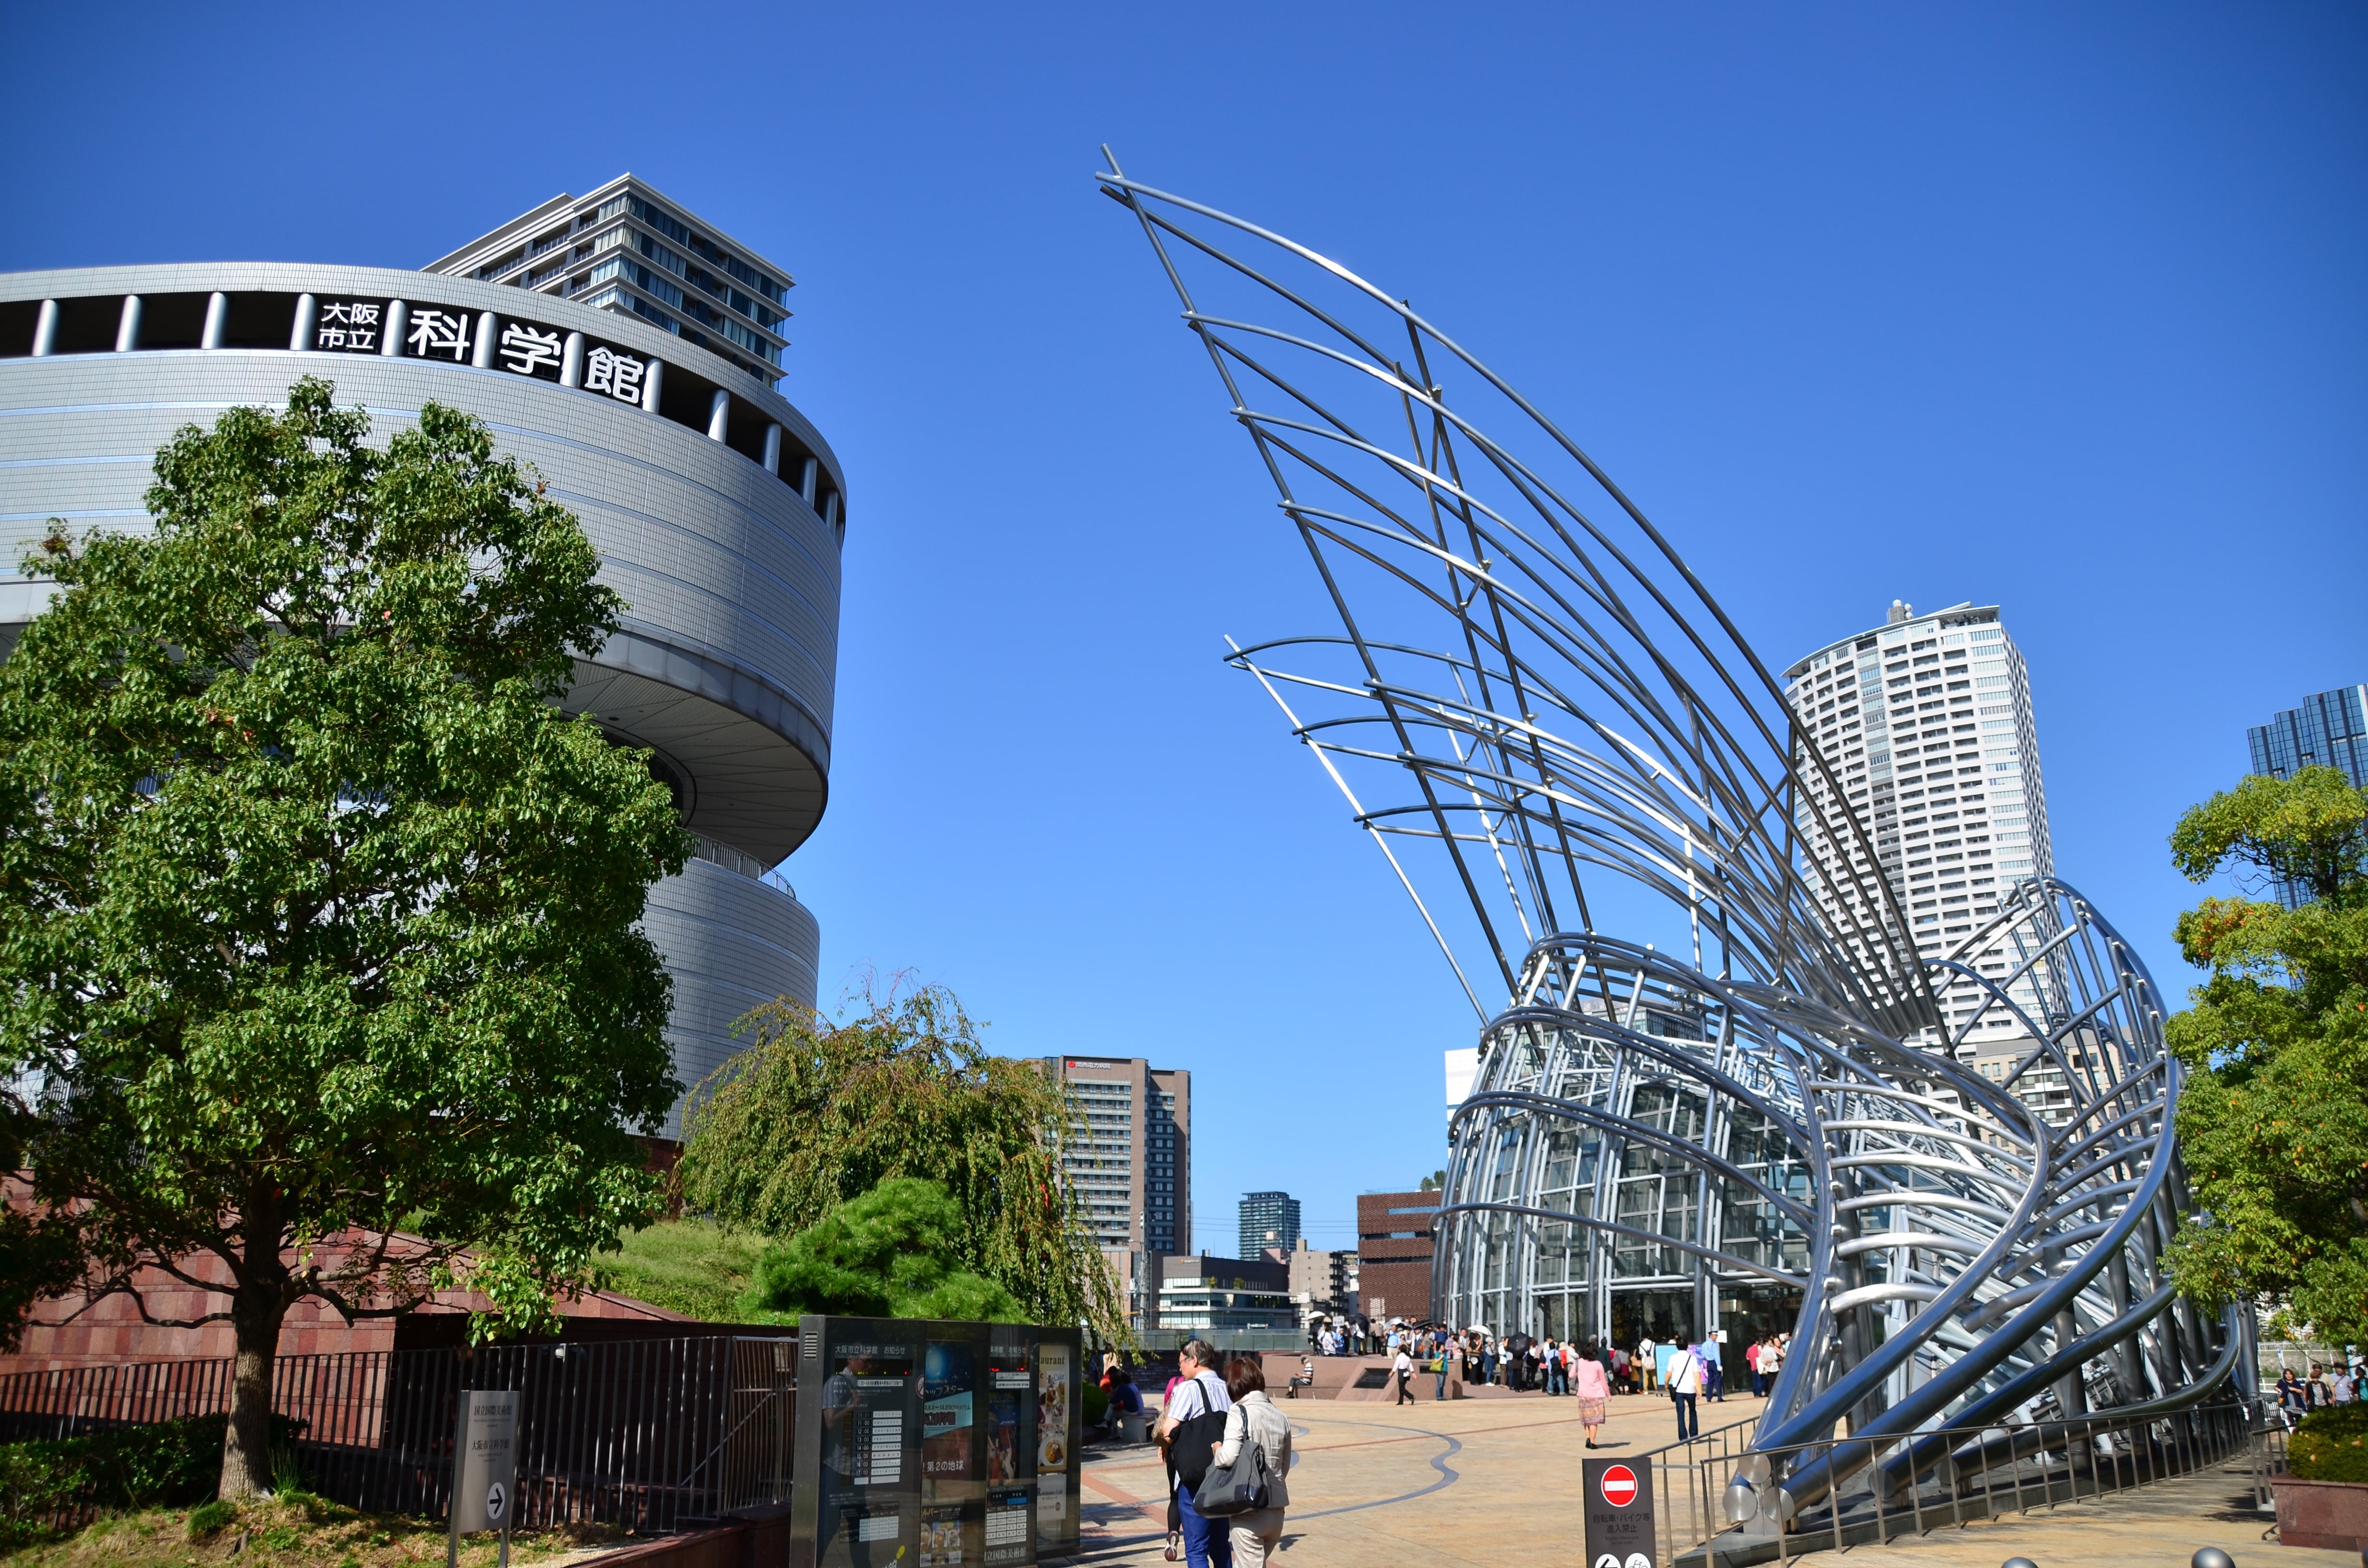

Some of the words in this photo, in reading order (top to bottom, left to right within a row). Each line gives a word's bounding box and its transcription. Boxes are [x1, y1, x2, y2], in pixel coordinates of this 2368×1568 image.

[321, 303, 380, 325] 大阪
[319, 327, 375, 349] 市立
[408, 310, 644, 404] 科学館
[836, 1346, 878, 1354] 大阪市立科学館
[1039, 1356, 1065, 1365] aurant
[474, 1405, 512, 1416] 国立国際美術館
[471, 1439, 509, 1451] 大阪市立科学館
[921, 1507, 938, 1517] ルバー
[1593, 1513, 1650, 1523] 自転車・バイク等
[1607, 1524, 1638, 1533] 進入禁止
[984, 1545, 1026, 1561] 立国際美術館
